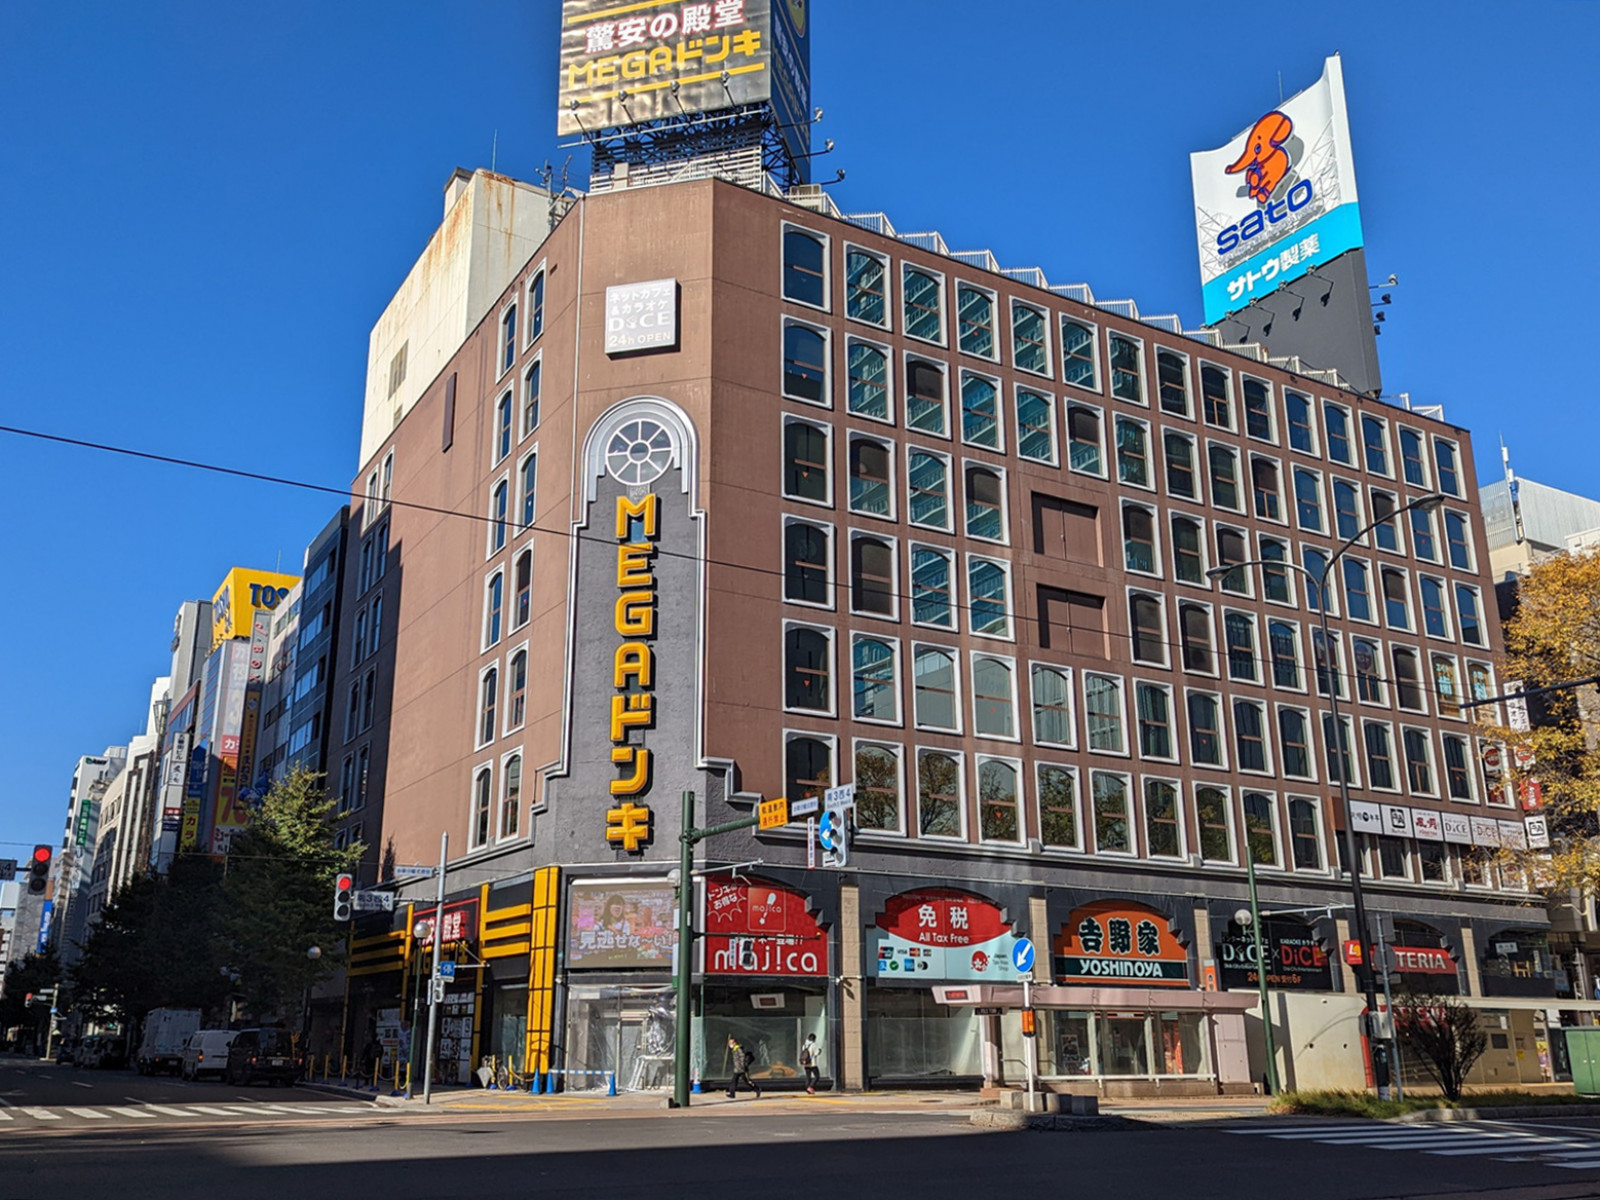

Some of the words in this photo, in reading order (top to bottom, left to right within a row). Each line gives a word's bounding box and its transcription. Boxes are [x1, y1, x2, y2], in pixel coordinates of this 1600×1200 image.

[585, 0, 745, 54] 驚安の殿堂
[568, 29, 762, 89] MEGAドンキ
[1217, 178, 1314, 256] sato
[1226, 232, 1321, 301] サトウ製薬
[610, 287, 672, 303] ネットカフェ
[637, 332, 671, 344] OPEN
[605, 492, 657, 852] MEGAドンキ
[918, 904, 969, 929] 免税
[919, 933, 930, 942] All
[932, 933, 948, 943] Tax
[950, 933, 970, 944] Free
[1080, 958, 1164, 978] YOSHINOYA
[1371, 950, 1447, 970] TERIA
